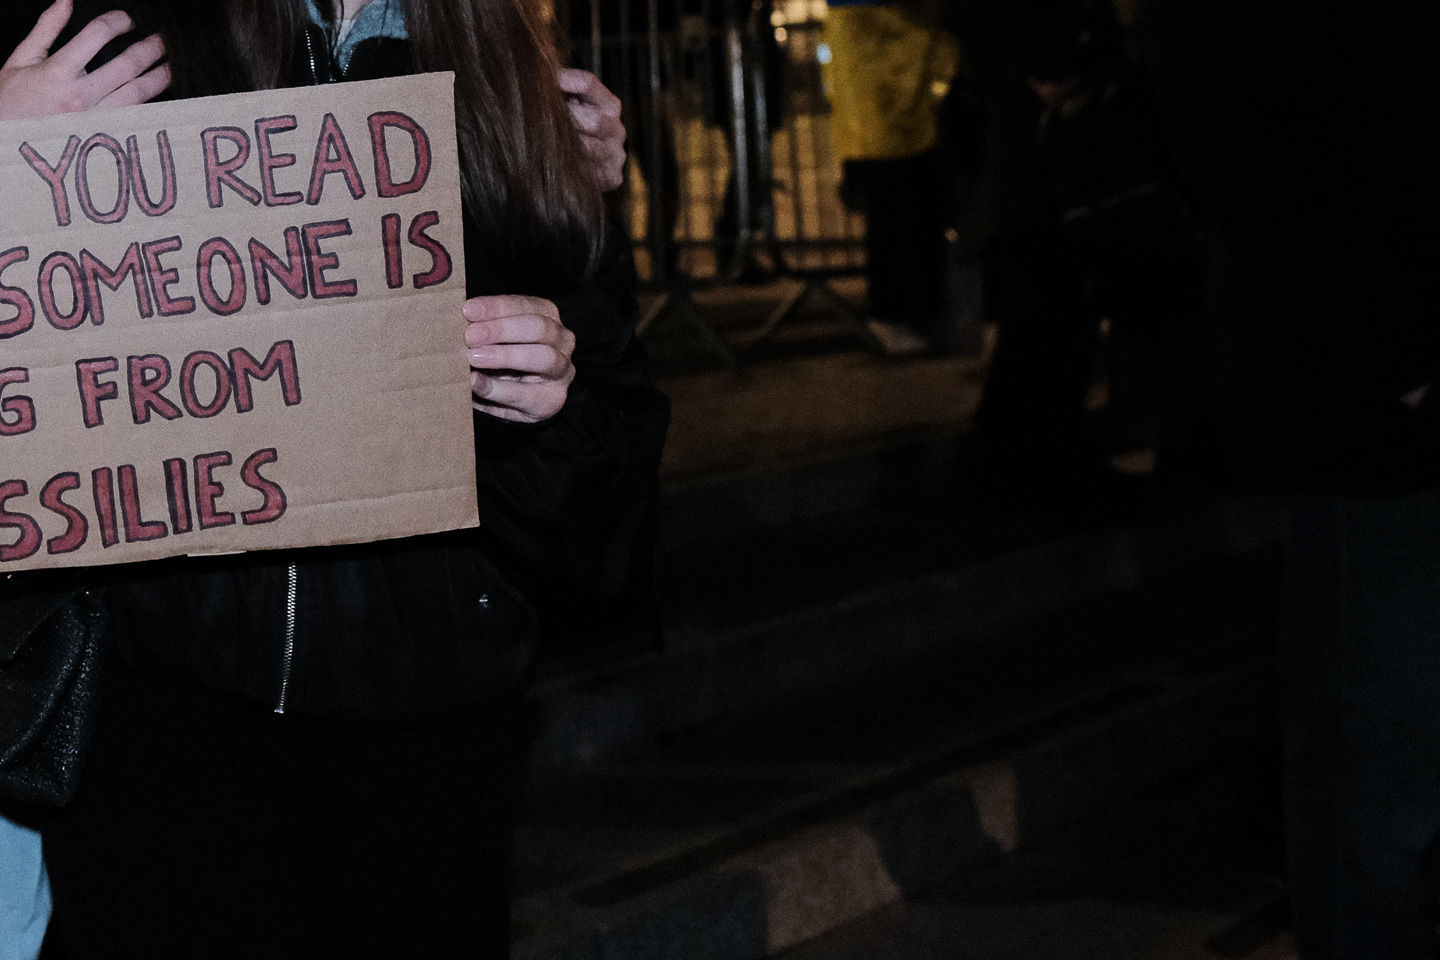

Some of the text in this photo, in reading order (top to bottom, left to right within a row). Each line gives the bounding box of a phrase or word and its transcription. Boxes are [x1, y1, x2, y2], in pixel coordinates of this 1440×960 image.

[18, 129, 178, 226] YOU
[199, 110, 433, 209] READ
[380, 209, 454, 290] IS
[75, 338, 303, 429] FROM
